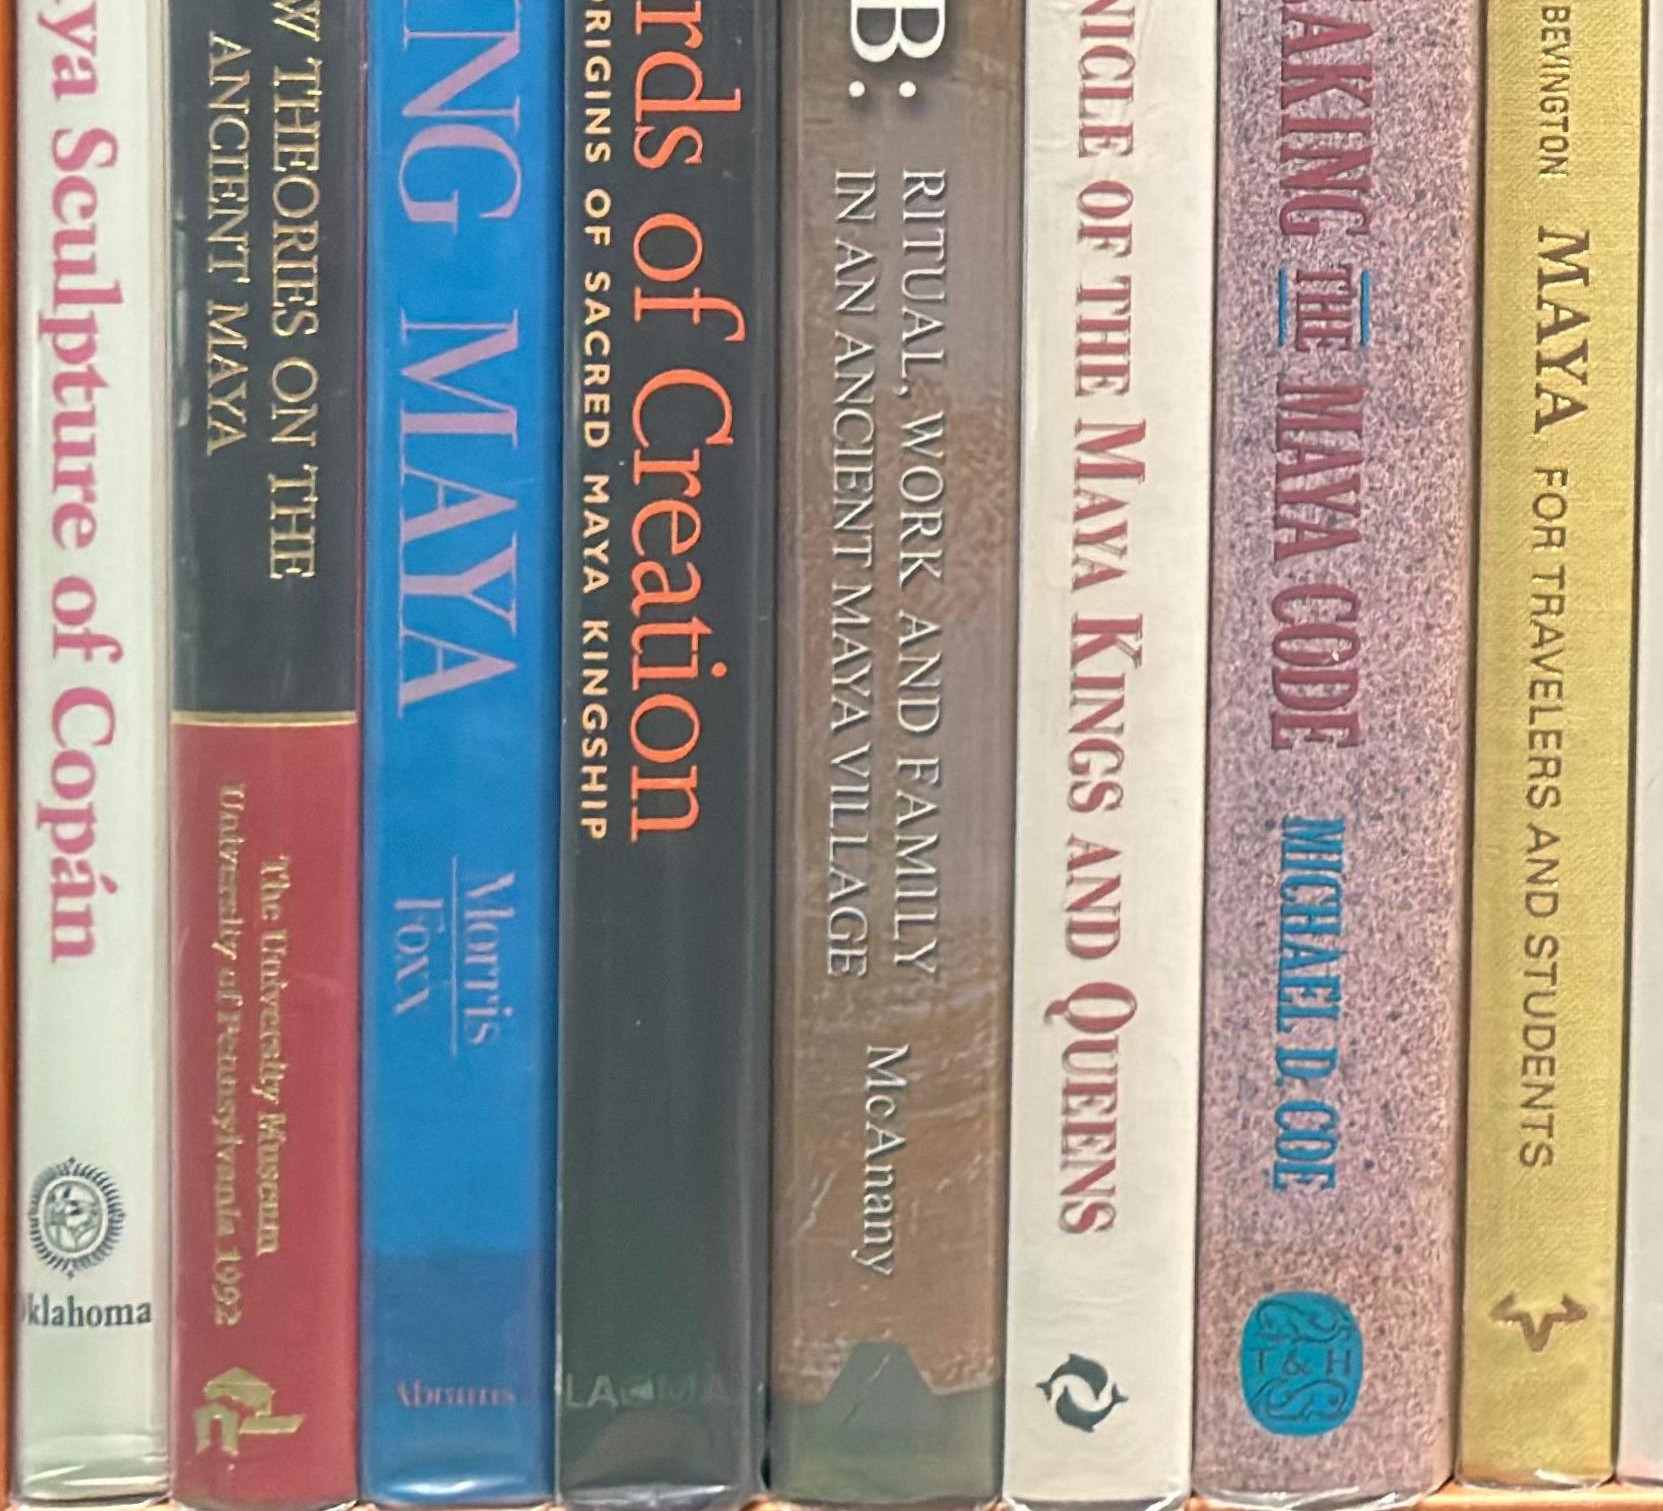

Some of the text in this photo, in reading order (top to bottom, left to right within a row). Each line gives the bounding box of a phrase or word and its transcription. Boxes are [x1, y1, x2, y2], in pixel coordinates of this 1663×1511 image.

[1538, 5, 1571, 179] BEVINGTON
[206, 30, 250, 457] ANCIENT MAYA
[270, 58, 322, 337] THEORIES
[584, 189, 611, 246] OF
[631, 212, 745, 342] of
[1077, 181, 1133, 258] OF
[38, 127, 122, 550] Sculpture
[583, 270, 611, 450] SACRED
[1075, 275, 1130, 397] THE
[1296, 267, 1354, 353] THE
[270, 359, 320, 446] ON
[1273, 383, 1366, 562] MAYA
[269, 464, 317, 580] THE
[399, 309, 519, 719] MAYA
[582, 474, 609, 594] MAYA
[826, 169, 876, 979] IN AN ANCIENT MAYA VILLAGE
[894, 169, 946, 981] RITUAL, WORK AND FAMILY
[1072, 417, 1146, 592] MAYA
[51, 578, 125, 664] of
[629, 369, 733, 841] Creation
[1271, 583, 1359, 750] CODE
[580, 620, 609, 840] KINGSHIP
[1066, 613, 1143, 814] KINGS
[1518, 226, 1591, 1169] MAYA FOR TRAVELERS AND STUDENTS
[36, 686, 119, 962] Copán
[1063, 835, 1122, 960] AND
[393, 896, 443, 1015] Foxx
[465, 872, 516, 1046] Morris
[1272, 816, 1344, 1192] MICHAEL D. COE
[211, 784, 246, 1326] University of Pennsylvania 1992
[252, 855, 291, 1258] The University Museum
[1044, 982, 1138, 1236] QUEENS
[852, 1045, 911, 1277] McAnany
[23, 1293, 152, 1327] klahoma
